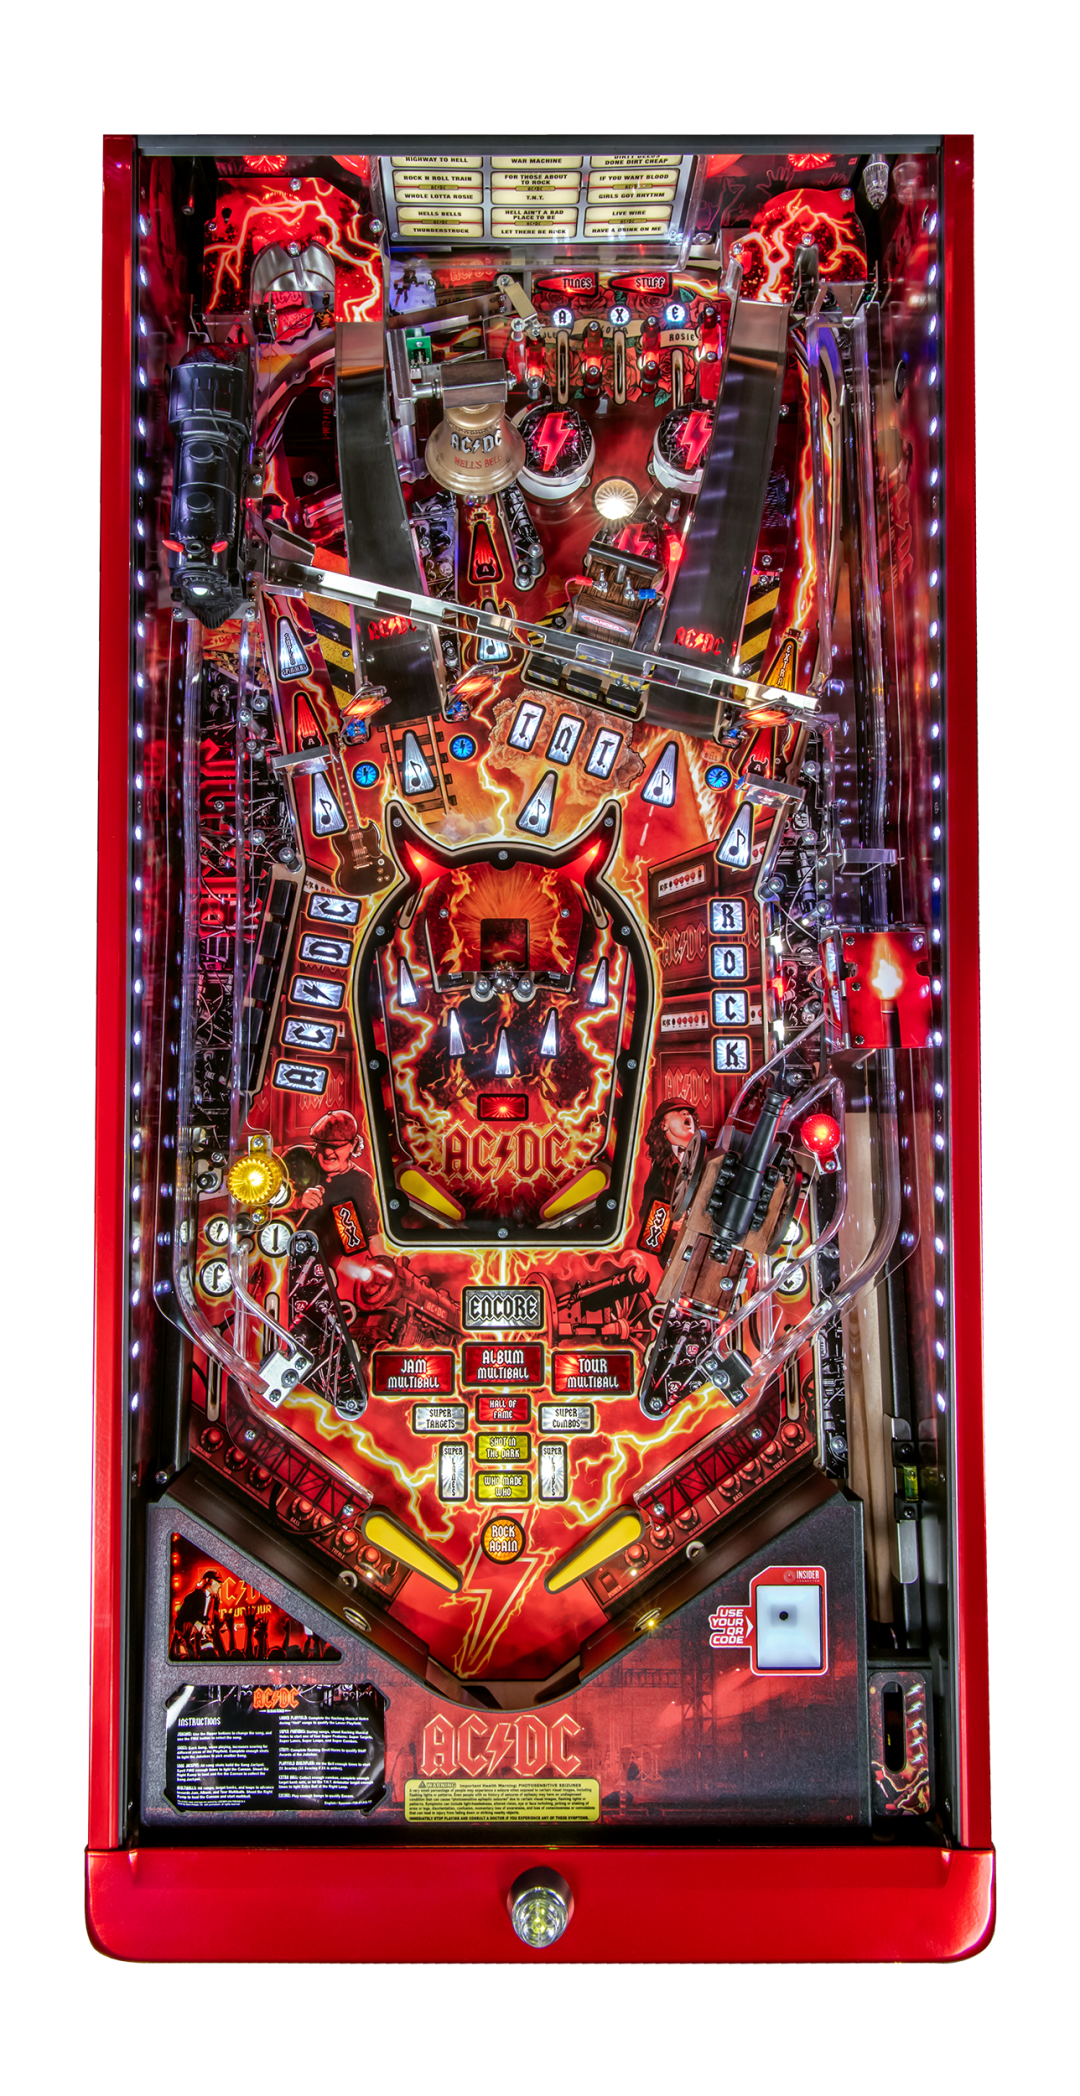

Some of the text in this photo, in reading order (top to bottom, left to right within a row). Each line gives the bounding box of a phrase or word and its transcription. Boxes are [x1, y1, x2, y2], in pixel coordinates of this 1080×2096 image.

[562, 278, 592, 289] TUNES
[635, 277, 666, 289] STUFF
[559, 310, 566, 324] A
[615, 308, 624, 323] X
[671, 307, 679, 320] E
[669, 333, 694, 341] ROSIE
[777, 644, 793, 686] EXTRA
[443, 1123, 570, 1182] AC/DC
[469, 1294, 538, 1321] ENCORE
[481, 1349, 525, 1365] ALBUM
[400, 1358, 427, 1374] JAM
[578, 1358, 608, 1375] TOUR
[476, 1366, 530, 1380] MULTIBALL
[387, 1375, 440, 1390] MULTIBALL
[567, 1375, 620, 1390] MULTIBALL
[489, 1399, 517, 1409] HALL OF
[429, 1408, 452, 1418] SUPER
[493, 1410, 513, 1419] FAME
[555, 1408, 578, 1418] SUPER
[426, 1418, 456, 1428] TARGETS
[489, 1437, 517, 1446] SHOT IN
[444, 1447, 463, 1455] SUPER
[486, 1448, 520, 1458] THE DARK
[543, 1447, 562, 1455] SUPER
[772, 1457, 787, 1470] TREBLE
[484, 1476, 523, 1486] WHO MADE
[495, 1487, 512, 1497] WHO
[732, 1491, 744, 1502] BASS
[290, 1516, 300, 1527] BASS
[491, 1525, 516, 1538] ROCK
[489, 1540, 518, 1553] AGAIN
[331, 1546, 346, 1560] TREBLE
[796, 1570, 820, 1579] INSIDER
[607, 1584, 623, 1598] POWER
[720, 1609, 744, 1617] USE
[712, 1618, 744, 1626] YOUR
[726, 1627, 744, 1636] QR
[713, 1636, 744, 1644] CODE
[253, 1687, 300, 1709] AC/DC
[177, 1717, 221, 1727] INSTRUCTIONS
[420, 1713, 582, 1777] AC/DC
